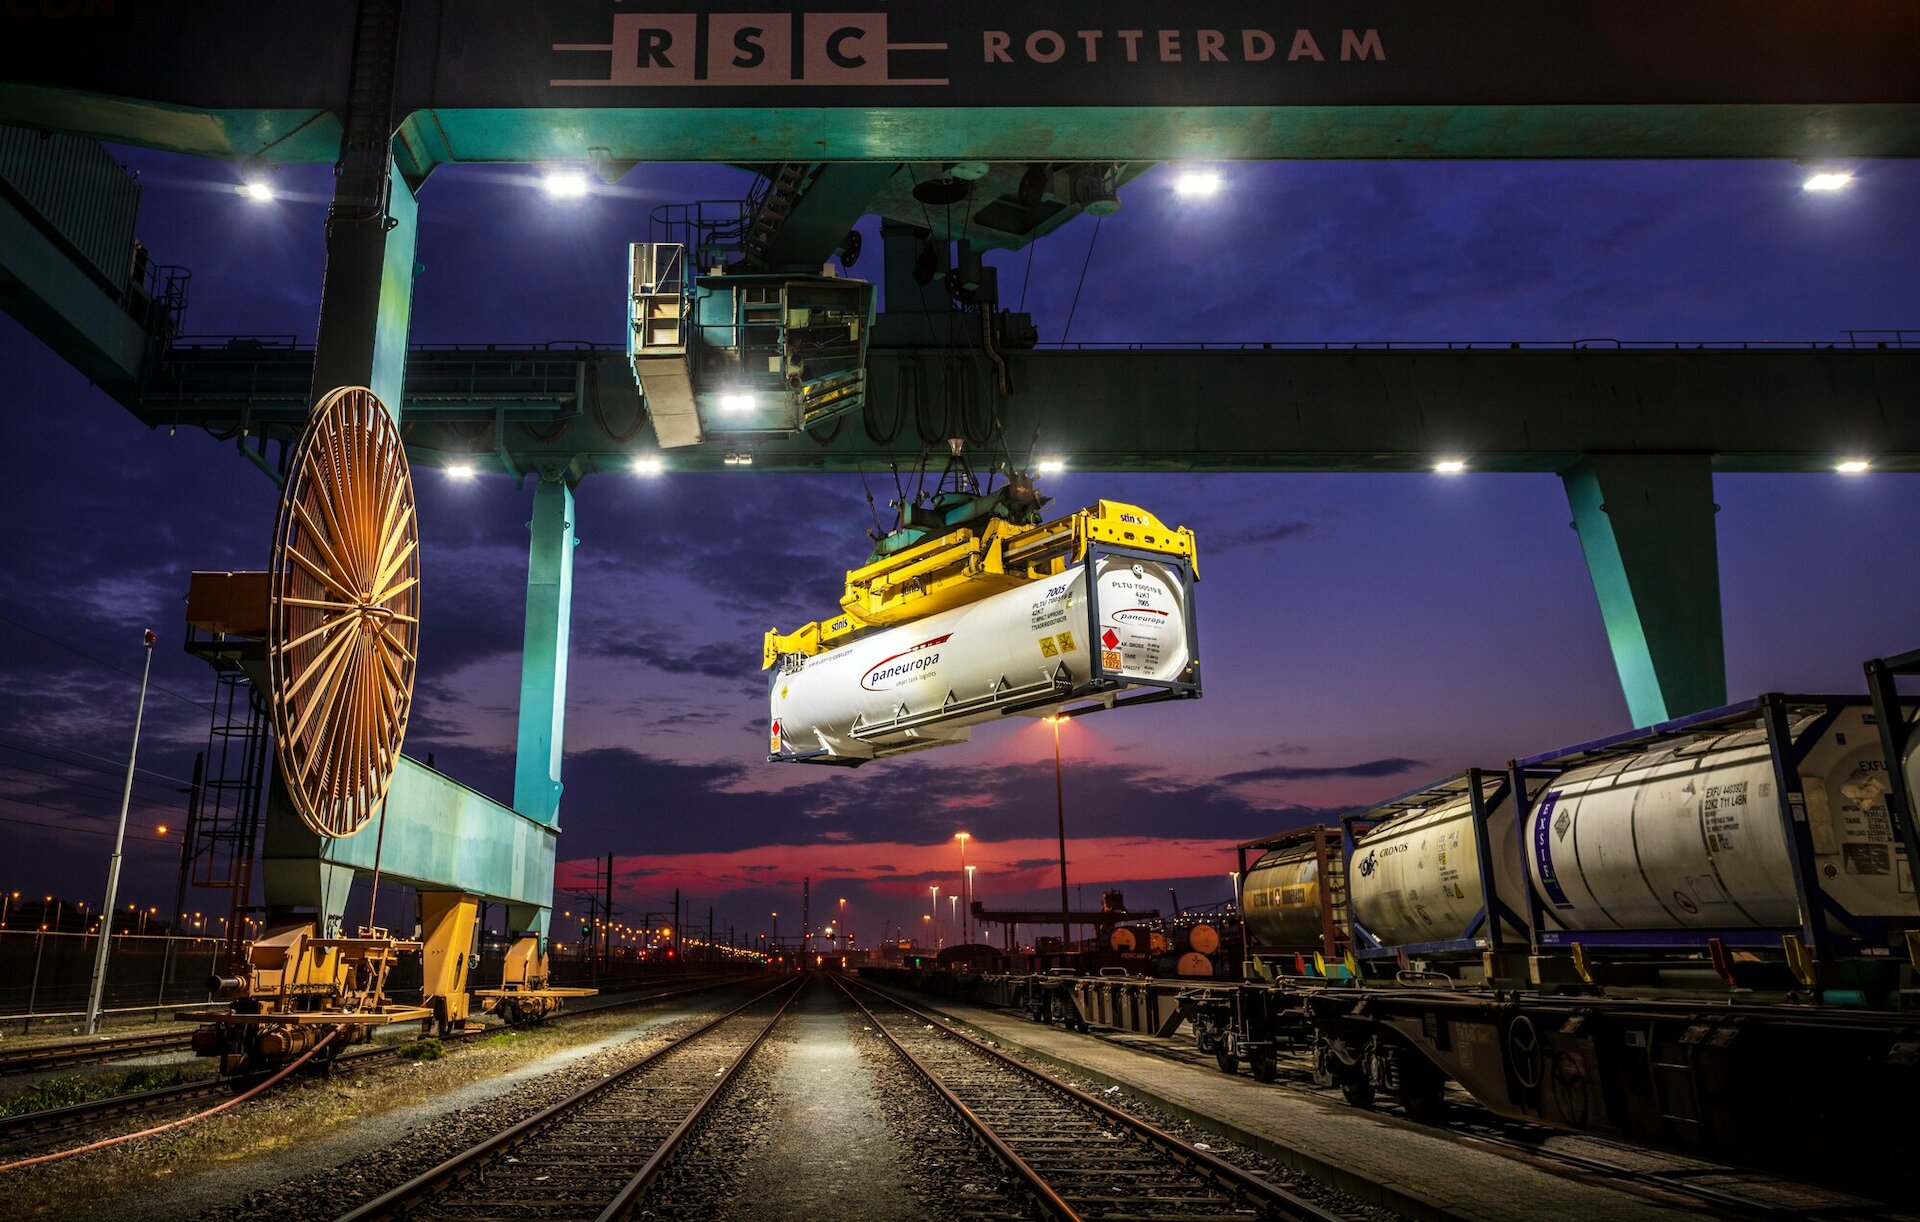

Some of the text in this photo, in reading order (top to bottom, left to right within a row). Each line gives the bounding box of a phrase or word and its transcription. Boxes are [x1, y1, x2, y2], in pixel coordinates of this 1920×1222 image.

[636, 26, 1387, 69] RSC ROTTERDAM
[1112, 581, 1132, 589] PLTU
[1046, 584, 1067, 599] 7005
[1135, 591, 1150, 599] 42K7
[1032, 600, 1047, 609] PLTU
[1138, 599, 1150, 607] 7005
[1032, 607, 1044, 616] 42K7
[831, 617, 849, 633] stinis
[1120, 613, 1165, 625] paneuropa
[1105, 652, 1118, 660] 223
[871, 653, 940, 686] paneuropa
[1105, 660, 1120, 668] 1972
[919, 670, 937, 681] logistics
[1859, 760, 1888, 772] EXFU
[1706, 785, 1721, 798] EXFU
[1723, 782, 1743, 794] 440392
[1720, 796, 1730, 809] T11
[1731, 793, 1748, 807] L4BN
[1380, 843, 1408, 857] CRONOS
